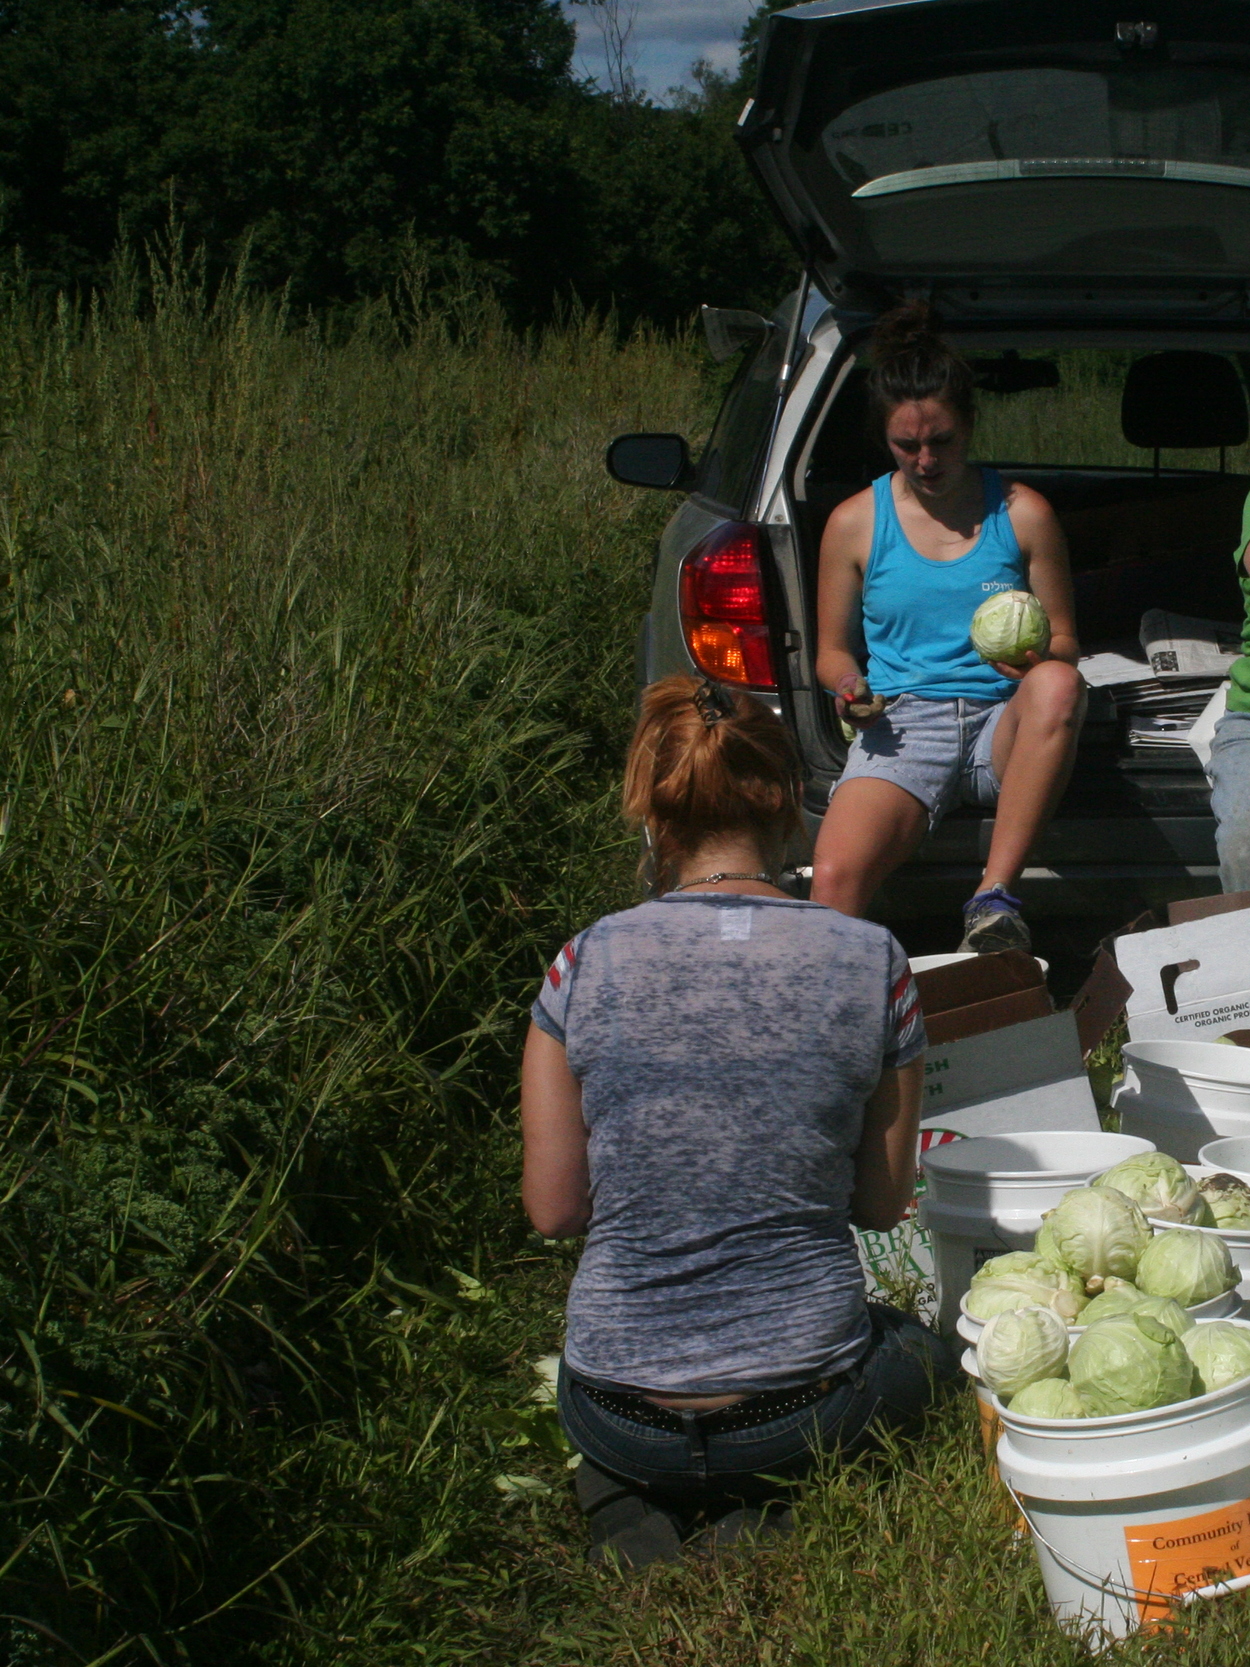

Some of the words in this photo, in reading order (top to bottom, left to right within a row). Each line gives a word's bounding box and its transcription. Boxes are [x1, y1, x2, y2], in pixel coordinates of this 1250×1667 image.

[1174, 1010, 1211, 1024] CERTIFIED
[1212, 1001, 1250, 1016] ORGANIC
[1194, 1014, 1232, 1028] ORGANIC
[1152, 1518, 1244, 1551] Community
[1230, 1540, 1241, 1551] of
